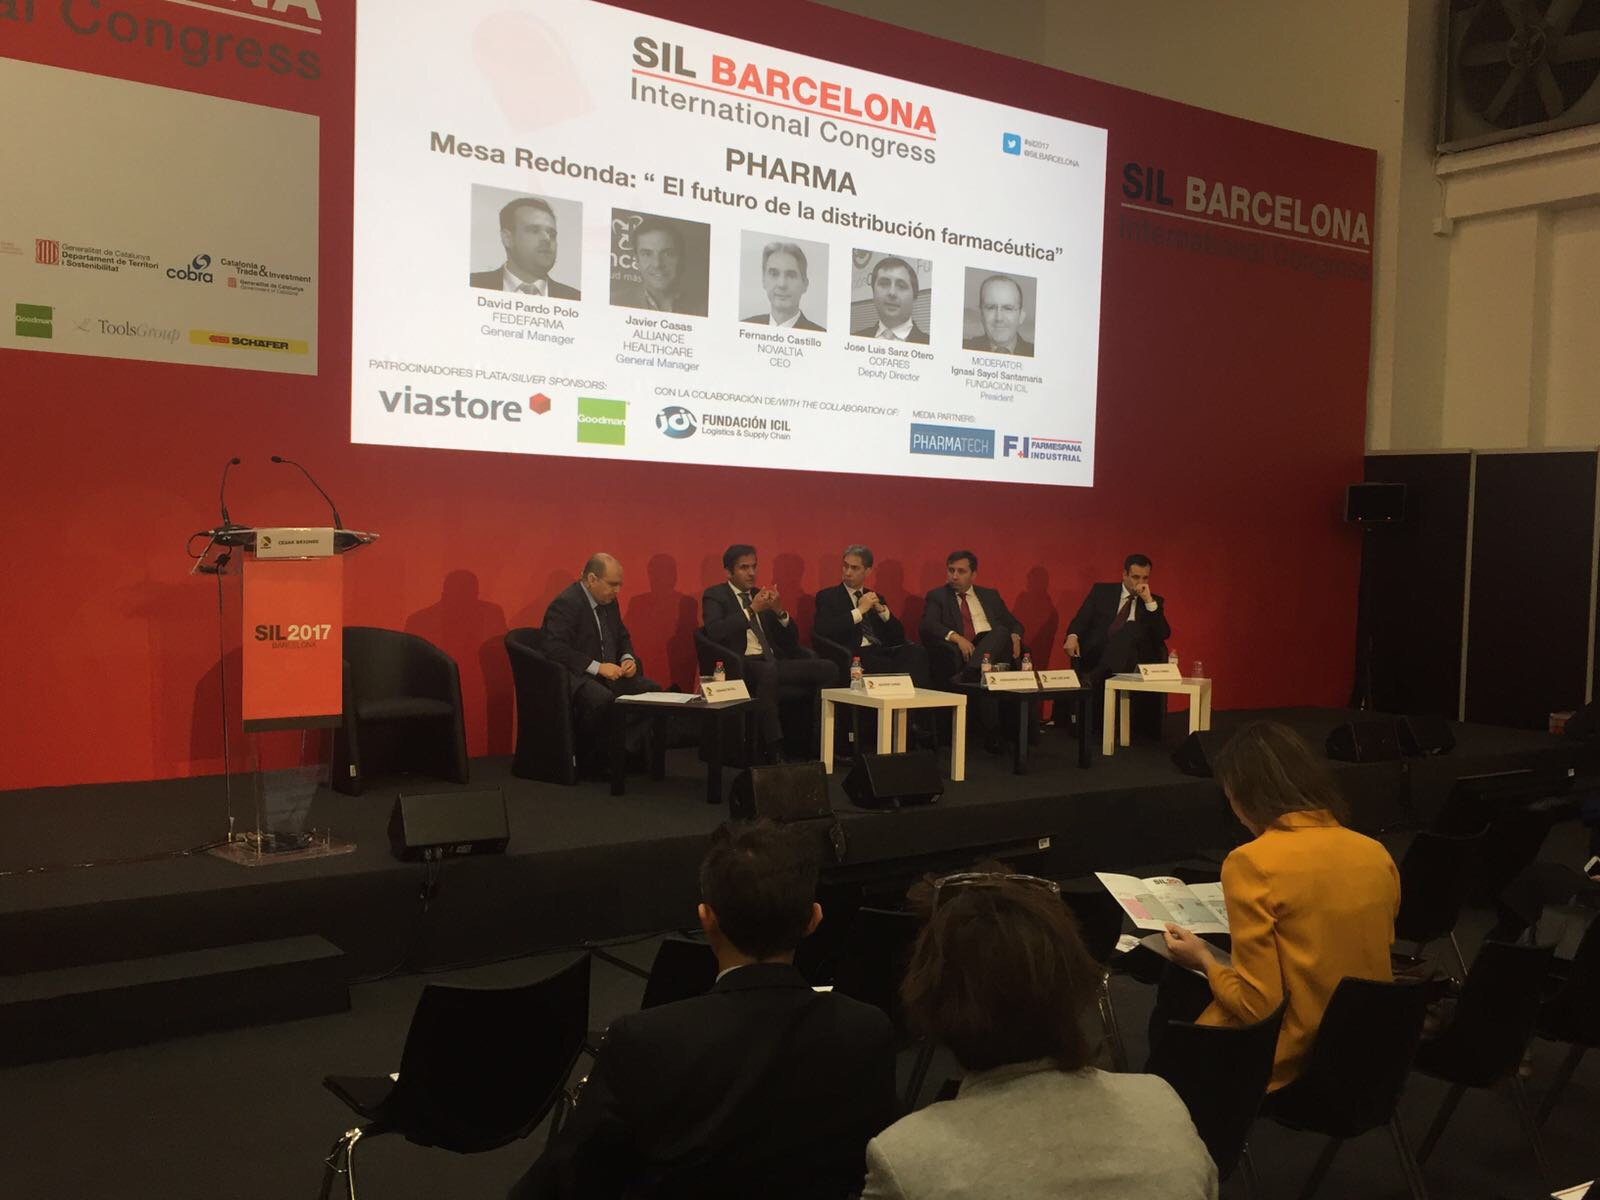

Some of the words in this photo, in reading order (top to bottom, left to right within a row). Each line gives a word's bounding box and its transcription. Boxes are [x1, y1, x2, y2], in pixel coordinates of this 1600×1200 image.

[61, 0, 321, 81] Congress
[631, 35, 697, 79] SIL
[711, 54, 937, 134] BARCELONA
[630, 77, 810, 138] International
[820, 121, 936, 164] Congress
[725, 147, 858, 196] PHARMA
[430, 131, 506, 165] Mesa
[515, 147, 637, 188] Redonda:
[663, 175, 684, 197] El
[691, 181, 757, 210] futuro
[764, 195, 791, 215] de
[798, 200, 815, 221] la
[821, 205, 936, 241] distribución
[940, 227, 1063, 263] farmacéutica”
[1121, 162, 1173, 206] SIL
[1185, 175, 1370, 246] BARCELONA
[1119, 212, 1265, 265] International
[61, 242, 102, 254] Generalitat
[103, 248, 113, 256] de
[114, 249, 151, 262] Catalunya
[61, 251, 115, 265] Departament
[116, 257, 127, 266] de
[128, 258, 159, 270] Territori
[66, 259, 119, 272] Sostenibilitat
[220, 257, 259, 270] Catalonia
[166, 264, 214, 284] cobra
[236, 266, 258, 276] Trade
[269, 270, 312, 284] Investment
[477, 296, 512, 311] David
[515, 300, 550, 315] Pardo
[553, 304, 580, 319] Polo
[492, 312, 564, 330] FEDEFARMA
[625, 315, 658, 328] Javier
[660, 319, 693, 332] Casas
[97, 319, 182, 344] ToolsGroup
[480, 325, 524, 339] General
[527, 330, 576, 346] Manager
[633, 329, 685, 345] ALLIANCE
[739, 329, 785, 344] Fernando
[787, 334, 822, 347] Castillo
[623, 341, 694, 358] HEALTHCARE
[757, 343, 804, 358] NOVALTIA
[844, 342, 866, 353] Jose
[867, 344, 886, 355] Luis
[888, 346, 909, 358] Sanz
[911, 348, 935, 361] Otero
[615, 353, 655, 367] General
[657, 358, 700, 372] Manager
[769, 357, 791, 369] CEO
[868, 356, 911, 370] COFARES
[368, 358, 473, 379] PATROCINADORES
[475, 369, 546, 386] PLATA/SILVER
[548, 376, 608, 391] SPONSORS:
[858, 367, 888, 381] Deputy
[889, 370, 920, 382] Director
[951, 366, 975, 376] Ignasi
[976, 368, 999, 380] Sayol
[1000, 371, 1043, 384] Santamaria
[378, 385, 523, 422] viastore
[653, 386, 677, 397] CON
[678, 389, 690, 398] LA
[691, 390, 763, 405] COLABORACIÓN
[764, 396, 800, 408] DE/WITH
[801, 400, 819, 410] THE
[819, 401, 886, 416] COLLABORATION
[577, 413, 626, 427] Goodman
[701, 413, 767, 430] FUNDACIÓN
[770, 419, 792, 432] ICIL
[912, 410, 936, 421] MEDIA
[701, 427, 736, 437] Logistics
[736, 429, 742, 437] &
[743, 430, 770, 441] Supply
[770, 432, 792, 441] Chain
[913, 433, 990, 453] PHARMATECH
[1030, 452, 1082, 463] INDUSTRIAL
[254, 623, 332, 641] SIL2017
[271, 641, 317, 649] BARCELONA
